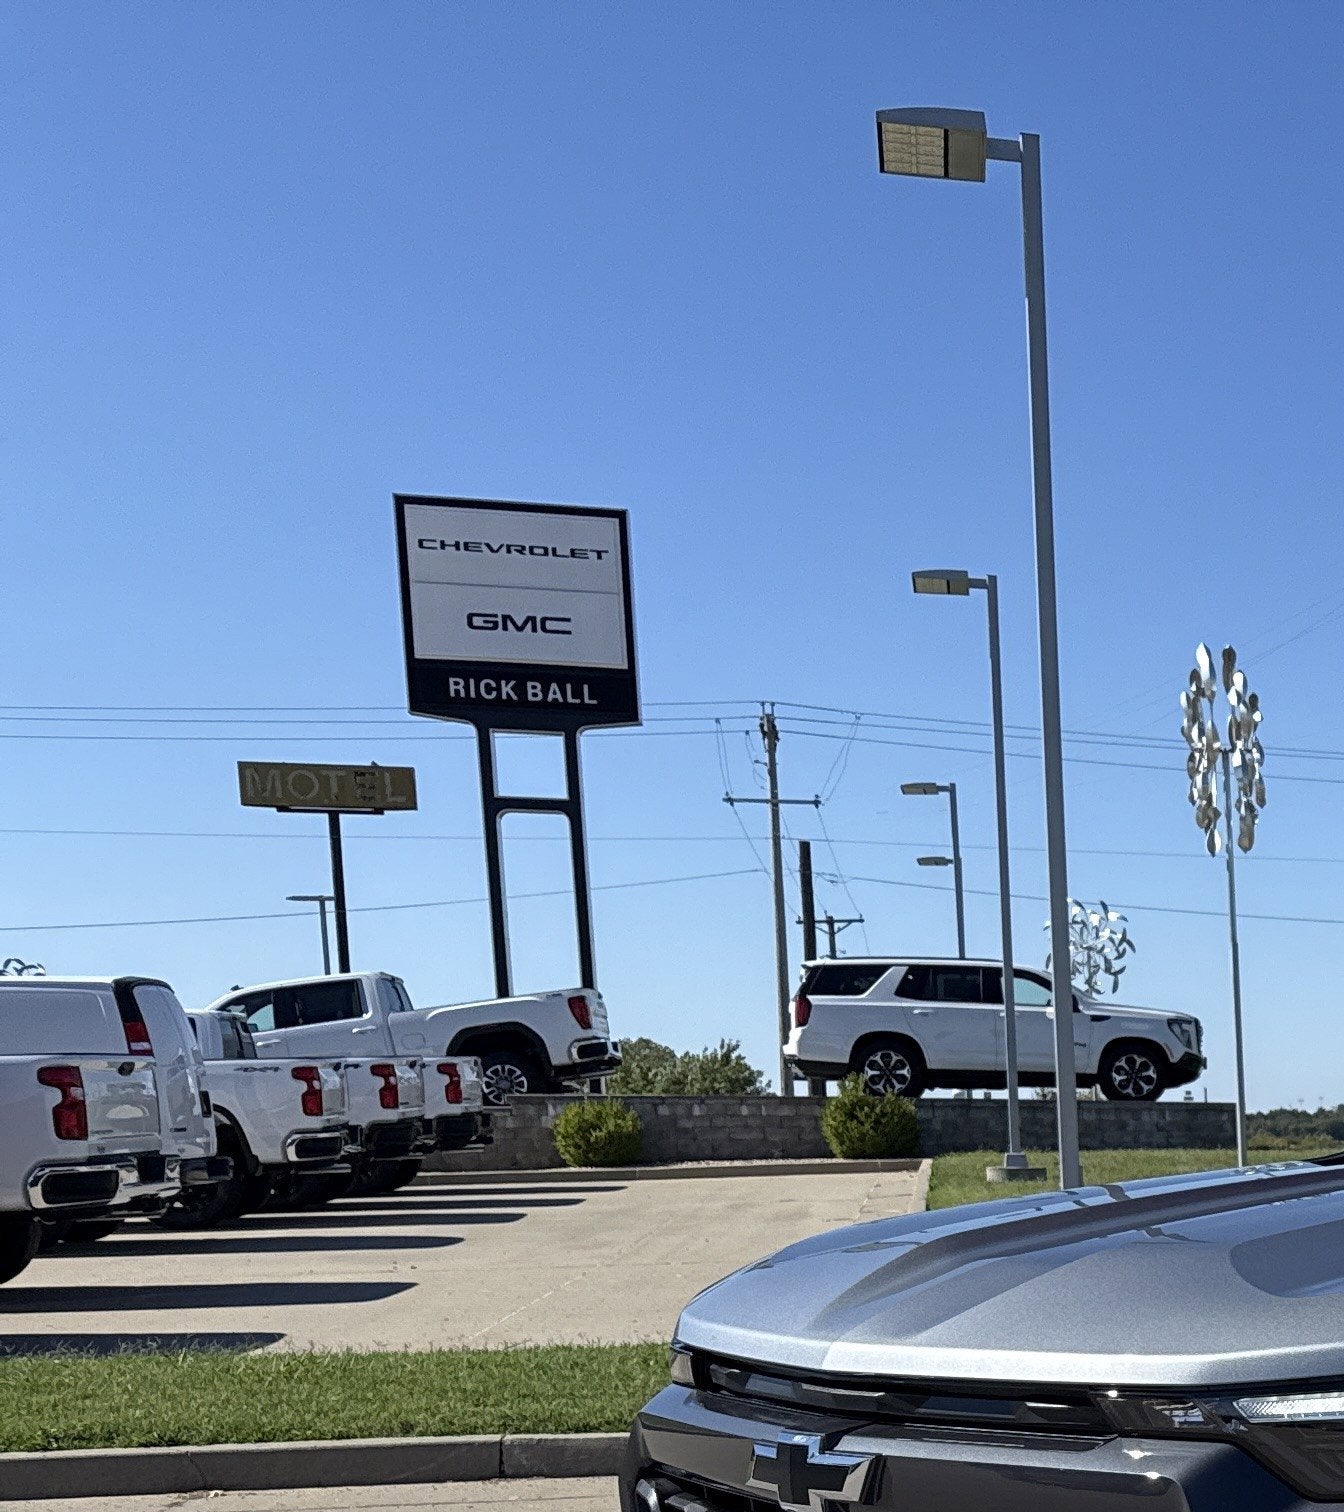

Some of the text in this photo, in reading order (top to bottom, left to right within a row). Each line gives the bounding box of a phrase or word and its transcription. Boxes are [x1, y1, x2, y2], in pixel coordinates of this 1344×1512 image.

[417, 538, 609, 560] CHEVROLET
[466, 612, 572, 635] GMC
[449, 677, 598, 705] RICK BALL
[245, 767, 406, 803] MOTEL
